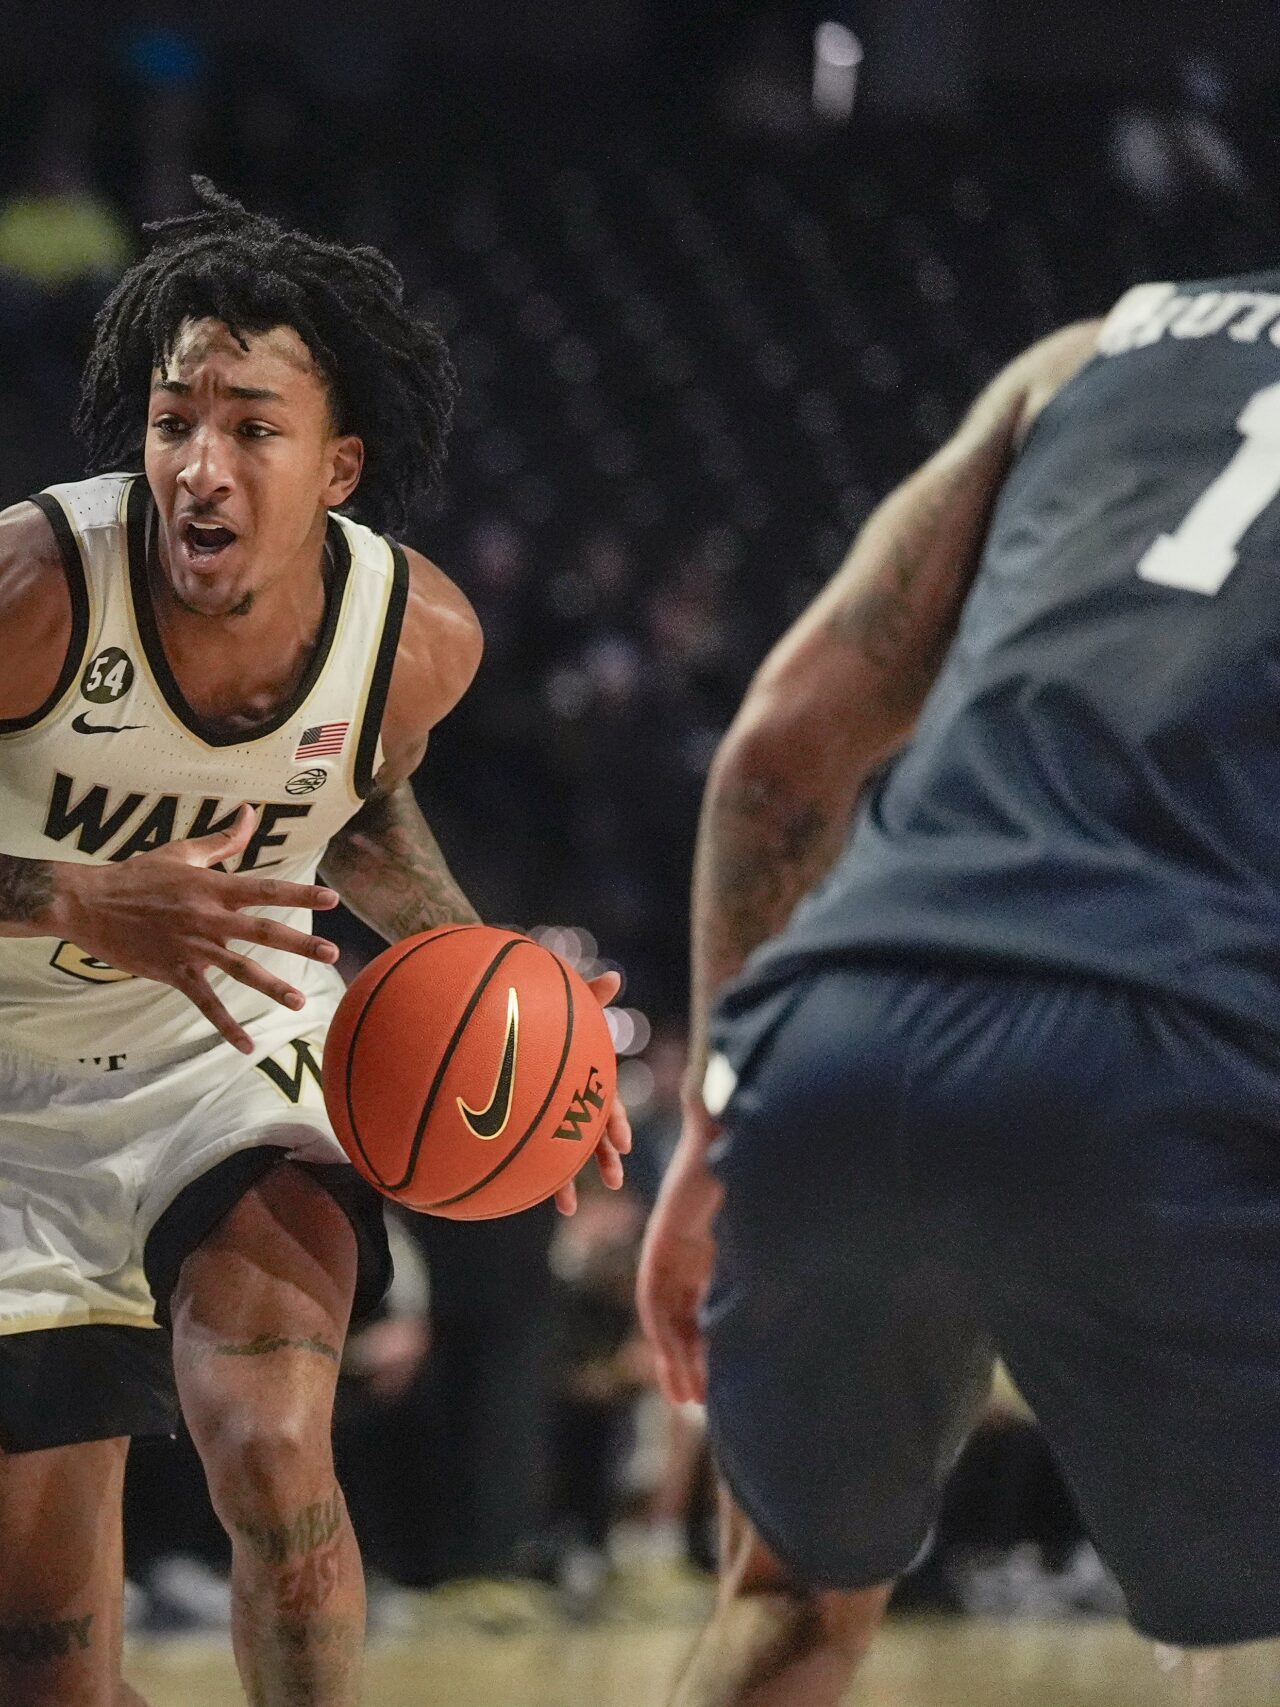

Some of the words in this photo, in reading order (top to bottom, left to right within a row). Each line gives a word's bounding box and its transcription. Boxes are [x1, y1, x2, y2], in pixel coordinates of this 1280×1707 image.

[86, 656, 128, 697] 54
[42, 770, 316, 873] WAKE
[551, 1065, 607, 1141] WF
